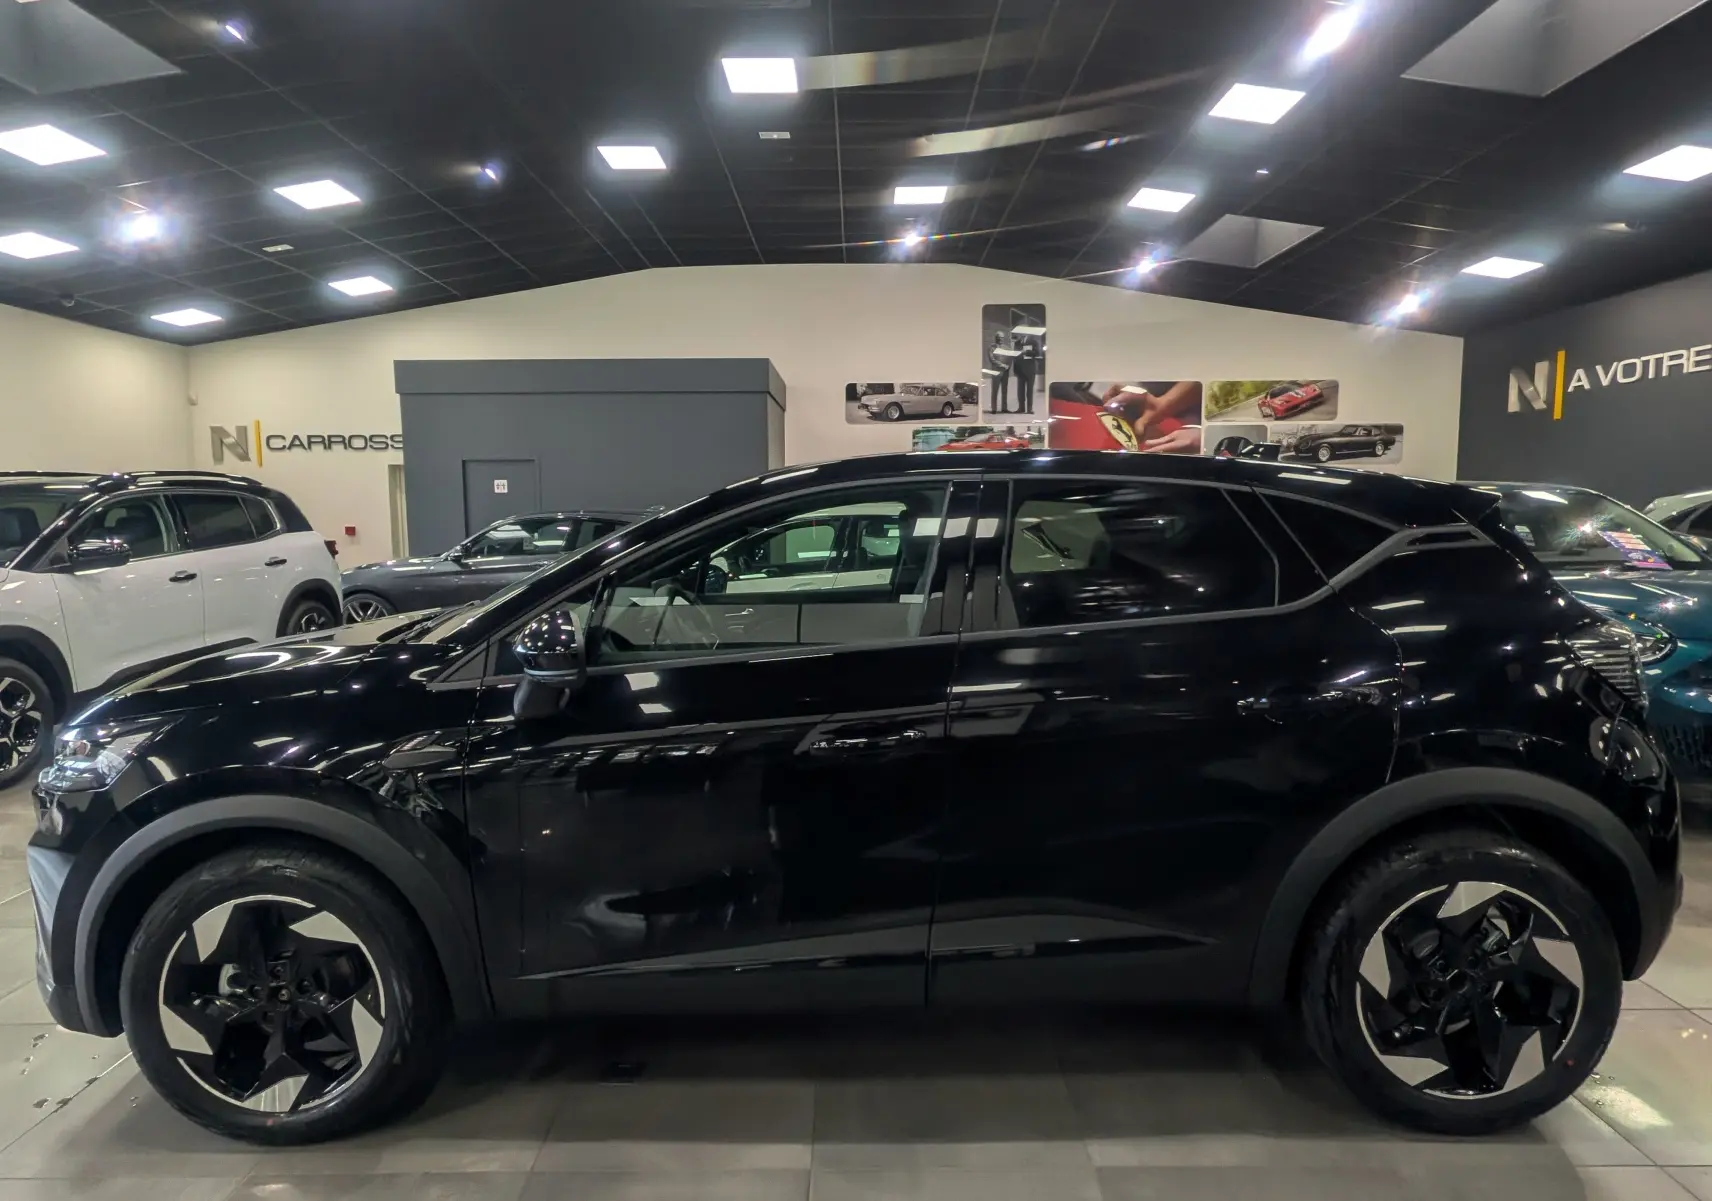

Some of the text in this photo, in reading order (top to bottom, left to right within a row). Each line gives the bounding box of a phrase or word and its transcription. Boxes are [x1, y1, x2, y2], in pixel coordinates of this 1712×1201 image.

[1507, 344, 1712, 413] N A VOTRE
[209, 425, 404, 466] N CARROSS
